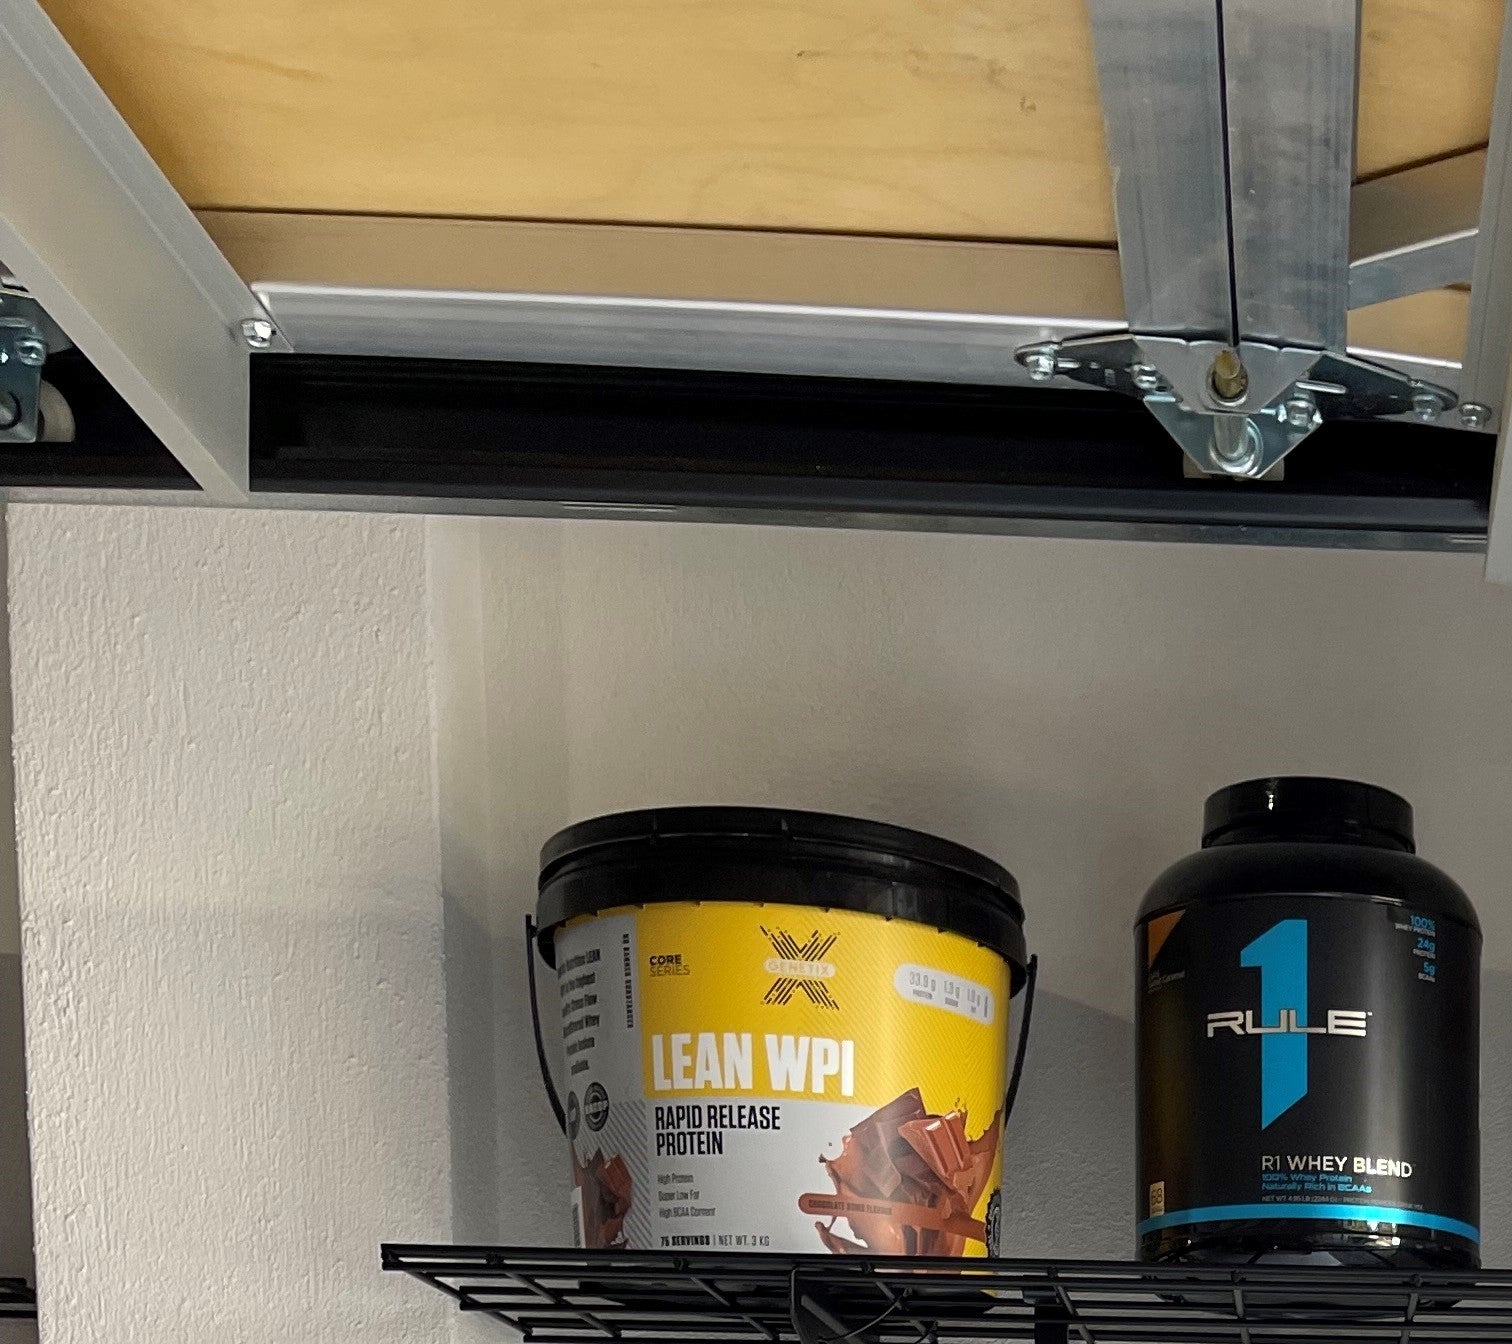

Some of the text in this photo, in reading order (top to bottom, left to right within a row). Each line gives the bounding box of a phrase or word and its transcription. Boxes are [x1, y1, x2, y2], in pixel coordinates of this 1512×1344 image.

[1410, 915, 1435, 931] 100%
[650, 954, 682, 966] CORE
[650, 964, 691, 977] SERIES
[1207, 1009, 1367, 1037] RULE
[1240, 919, 1308, 1130] 1
[652, 1032, 854, 1097] LEAN WPI
[655, 1104, 781, 1130] RAPID RELEASE
[656, 1131, 723, 1156] PROTEIN
[1261, 1155, 1413, 1178] R1 WHEY BLEND
[672, 1235, 711, 1247] SERVINGS
[719, 1235, 733, 1246] NET
[752, 1235, 757, 1246] 3
[759, 1235, 770, 1246] KG
